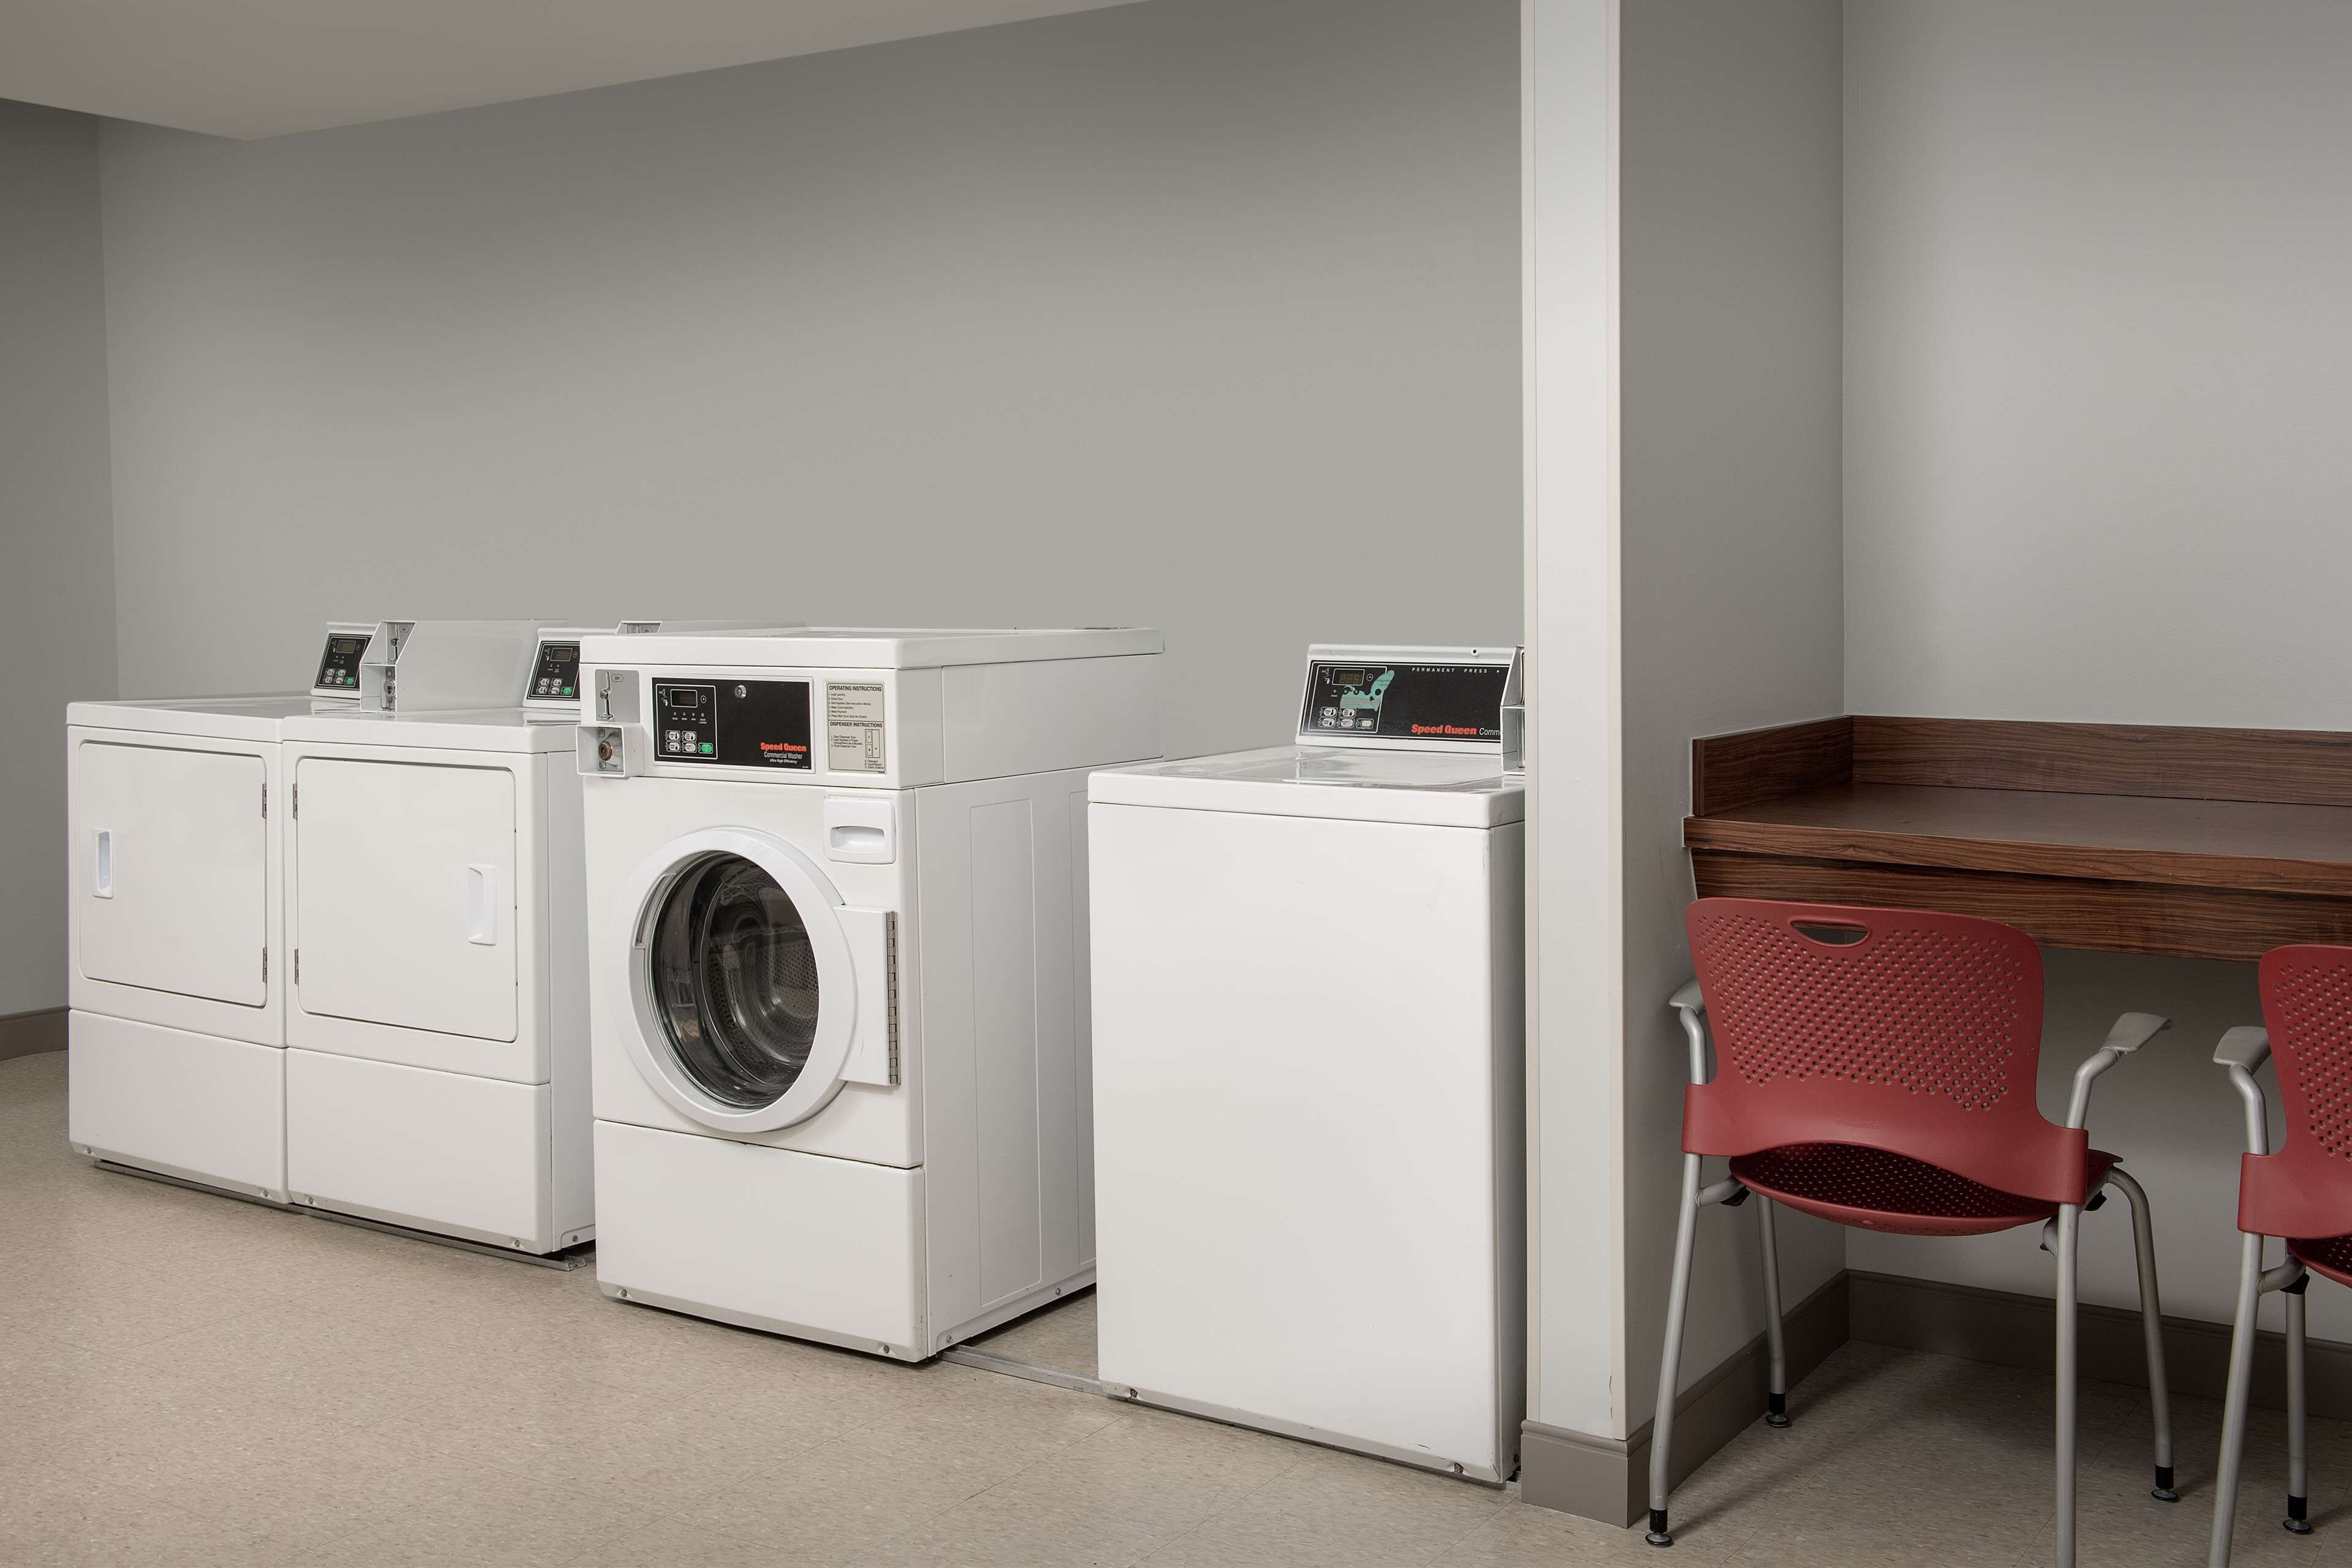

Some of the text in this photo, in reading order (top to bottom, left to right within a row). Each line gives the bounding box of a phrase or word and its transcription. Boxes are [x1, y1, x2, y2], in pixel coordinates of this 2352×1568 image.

[1411, 724, 1444, 734] Speed
[1444, 725, 1477, 735] Queen
[761, 742, 807, 752] Speed Queen
